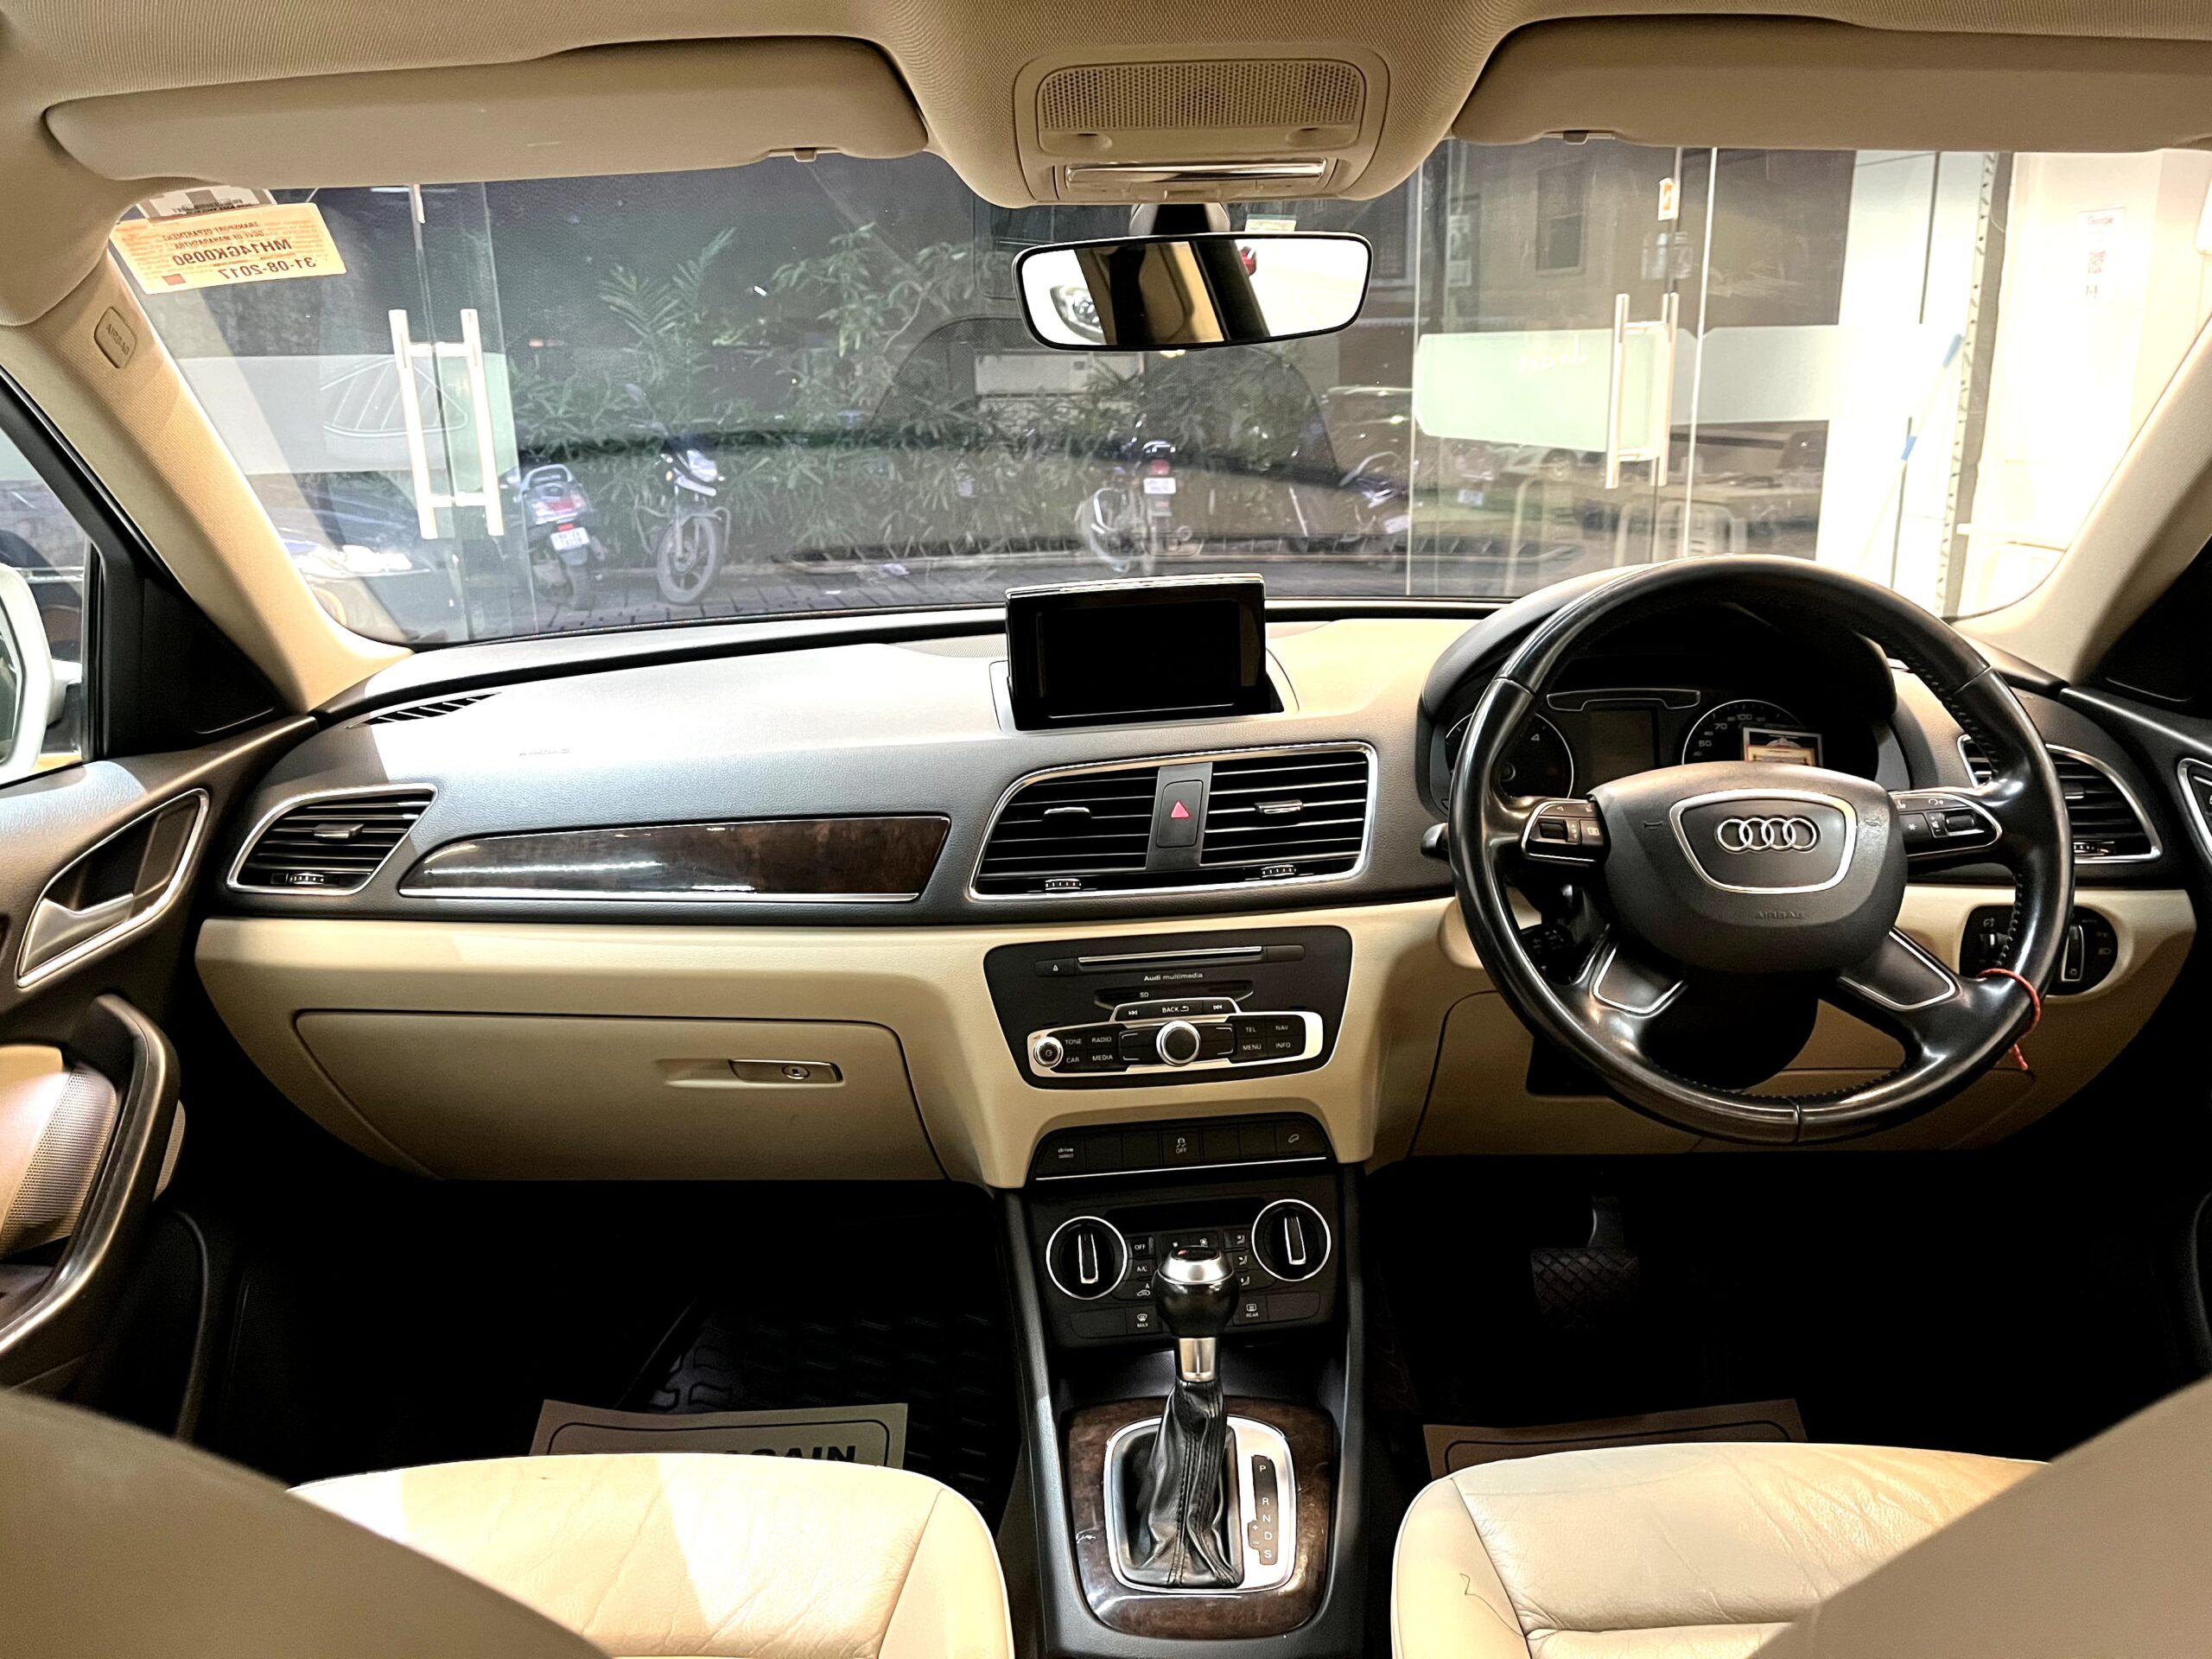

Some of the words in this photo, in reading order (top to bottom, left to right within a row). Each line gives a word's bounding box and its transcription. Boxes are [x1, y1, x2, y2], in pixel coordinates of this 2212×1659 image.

[1755, 911, 1805, 919] AIRBAG
[1163, 972, 1204, 981] multimedia
[1264, 1531, 1273, 1540] D
[1264, 1549, 1272, 1558] S
